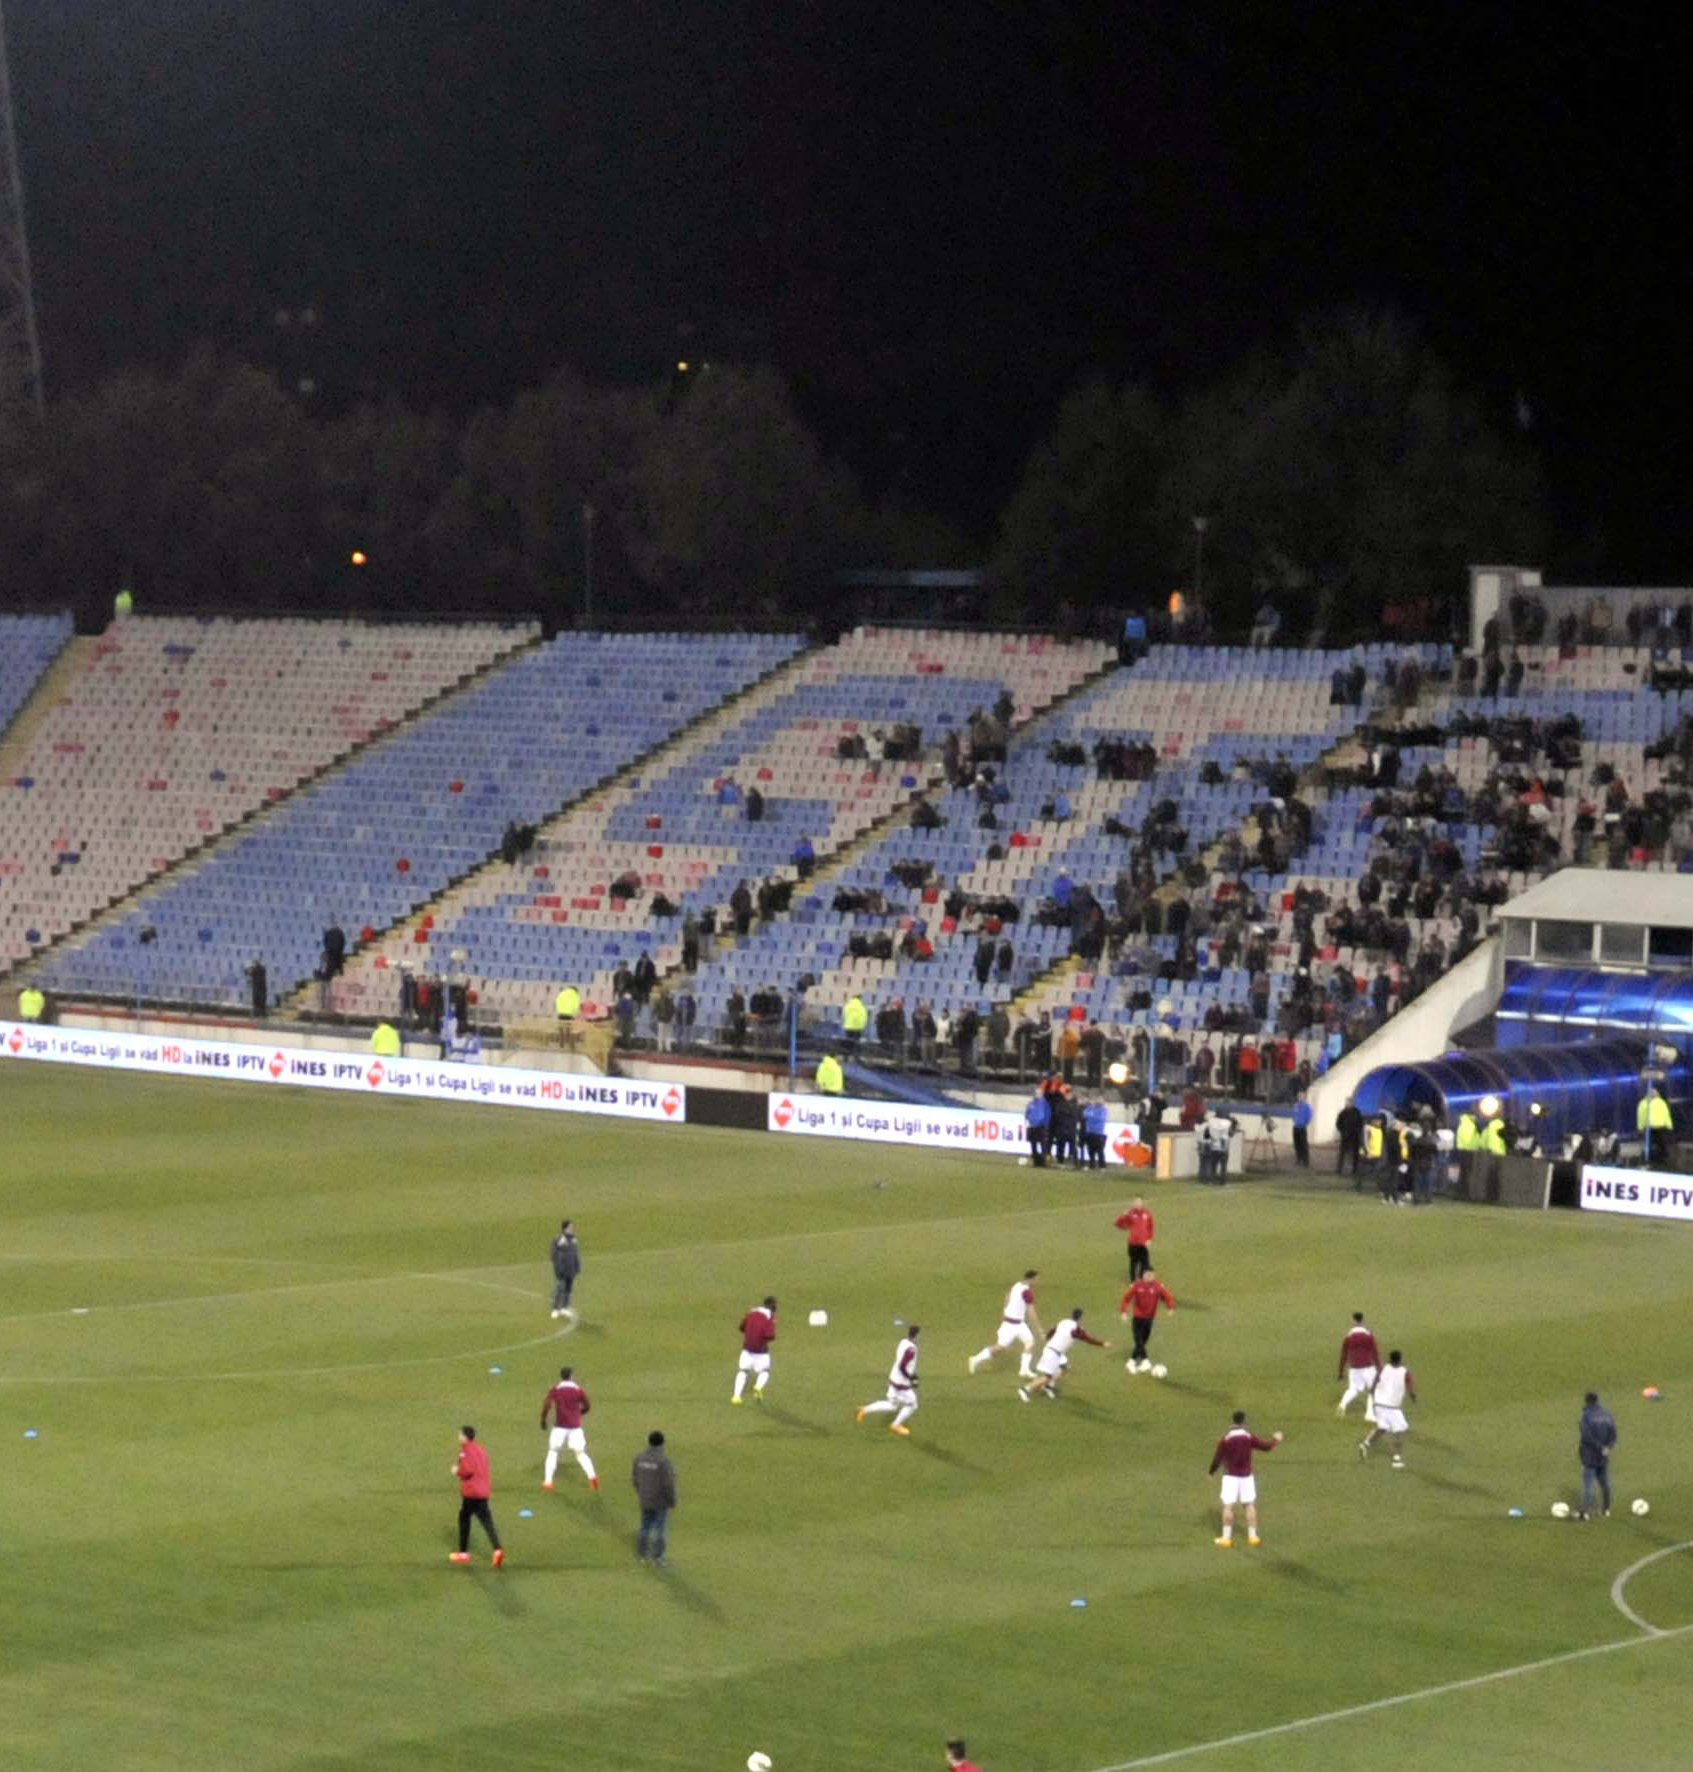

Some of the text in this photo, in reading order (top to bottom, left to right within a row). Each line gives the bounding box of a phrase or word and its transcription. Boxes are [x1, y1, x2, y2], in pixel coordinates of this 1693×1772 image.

[27, 1036, 47, 1052] Liga
[71, 1041, 96, 1056] Cupa
[125, 1048, 135, 1058] se
[162, 1046, 181, 1063] HD
[237, 1055, 265, 1070] IPTV
[334, 1063, 362, 1080] IPTV
[388, 1070, 411, 1087] Liga
[439, 1075, 466, 1092] Cupa
[499, 1083, 511, 1094] se
[541, 1081, 562, 1099] HD
[626, 1092, 658, 1108] IPTV
[798, 1108, 825, 1127] Liga
[857, 1112, 889, 1132] Cupa
[927, 1123, 940, 1134] se
[974, 1120, 999, 1140] HD
[1650, 1186, 1693, 1206] IPTV
